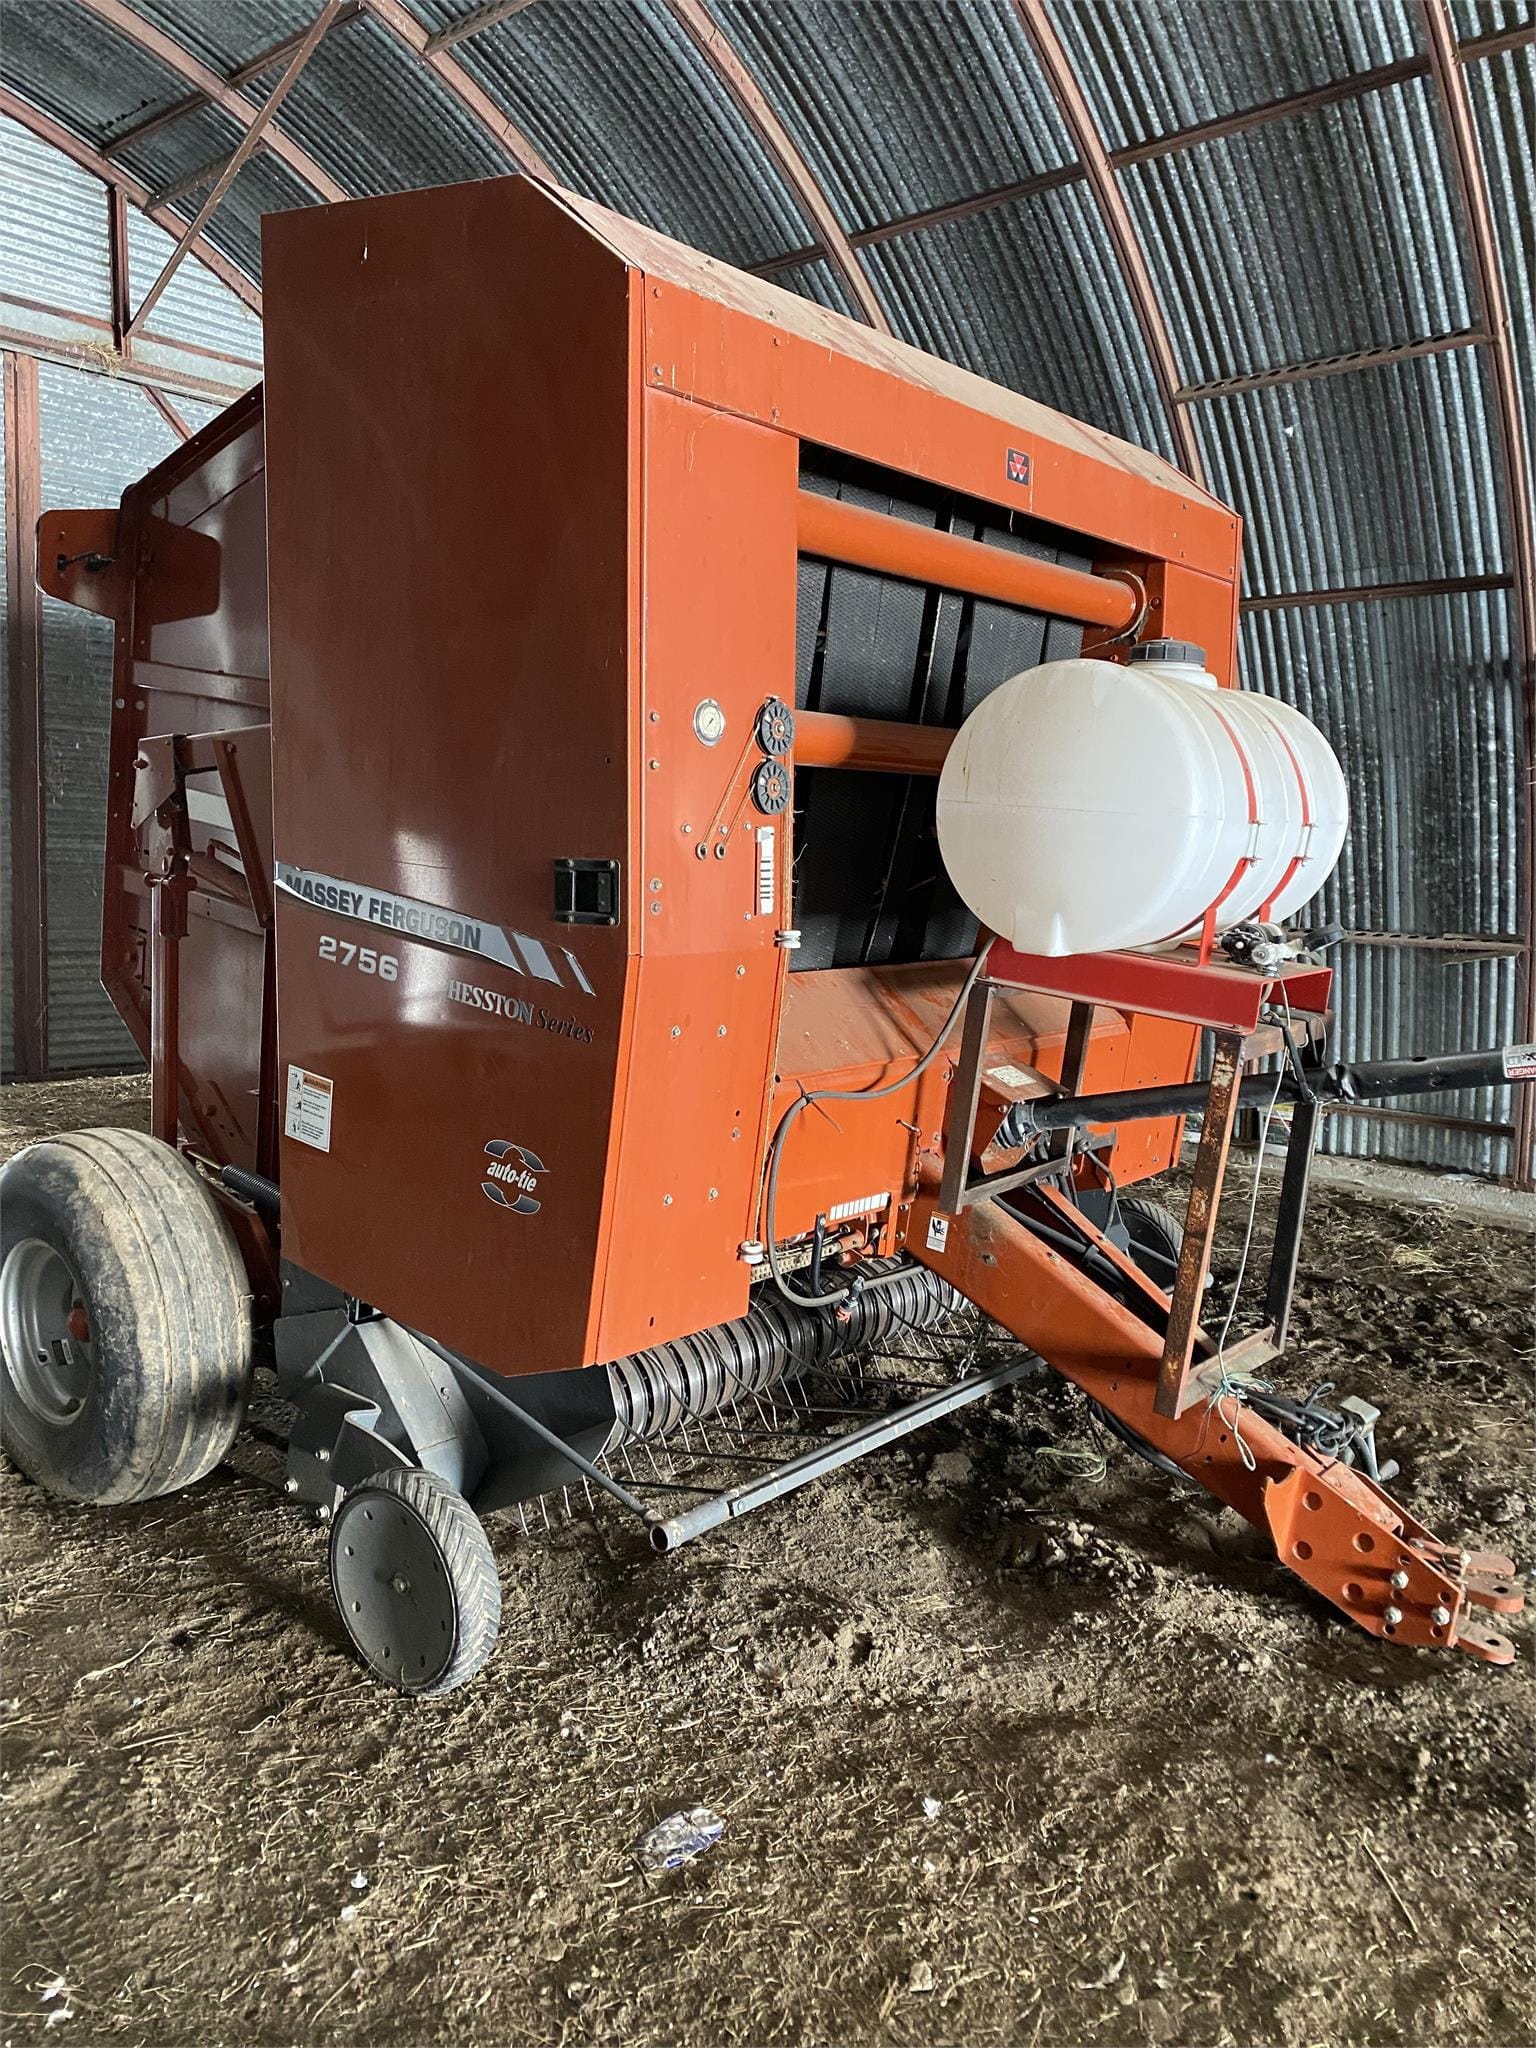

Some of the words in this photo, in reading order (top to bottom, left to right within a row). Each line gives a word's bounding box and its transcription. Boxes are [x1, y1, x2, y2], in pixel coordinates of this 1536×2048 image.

[285, 874, 363, 915] MASSEY
[368, 897, 482, 952] FERGUSON
[318, 935, 399, 982] 2756
[447, 979, 535, 1026] HESSTON
[535, 1008, 595, 1045] Series
[1508, 1067, 1536, 1076] ANGER
[486, 1161, 537, 1192] auto-tie
